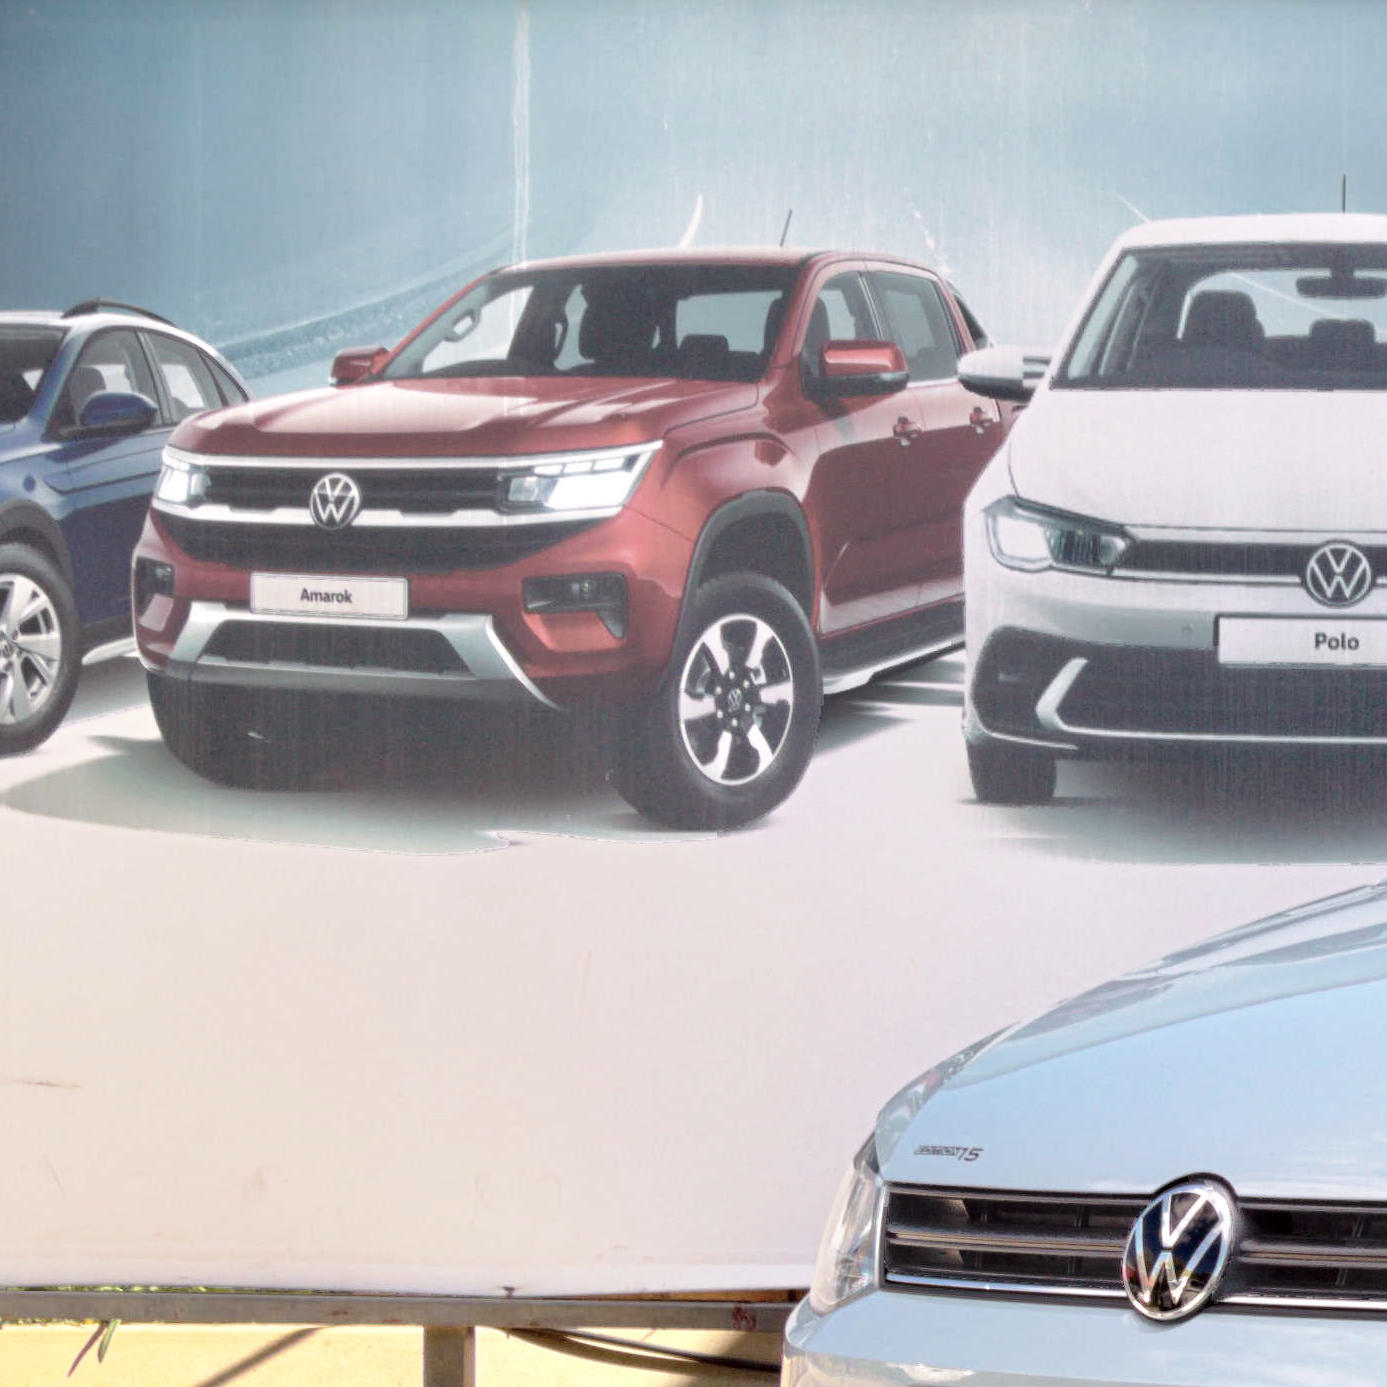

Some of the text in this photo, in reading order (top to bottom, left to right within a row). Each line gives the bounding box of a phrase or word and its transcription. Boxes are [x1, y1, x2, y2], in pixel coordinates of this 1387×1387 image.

[1306, 543, 1372, 607] VW
[300, 588, 353, 604] Amarok
[1315, 632, 1360, 650] Polo
